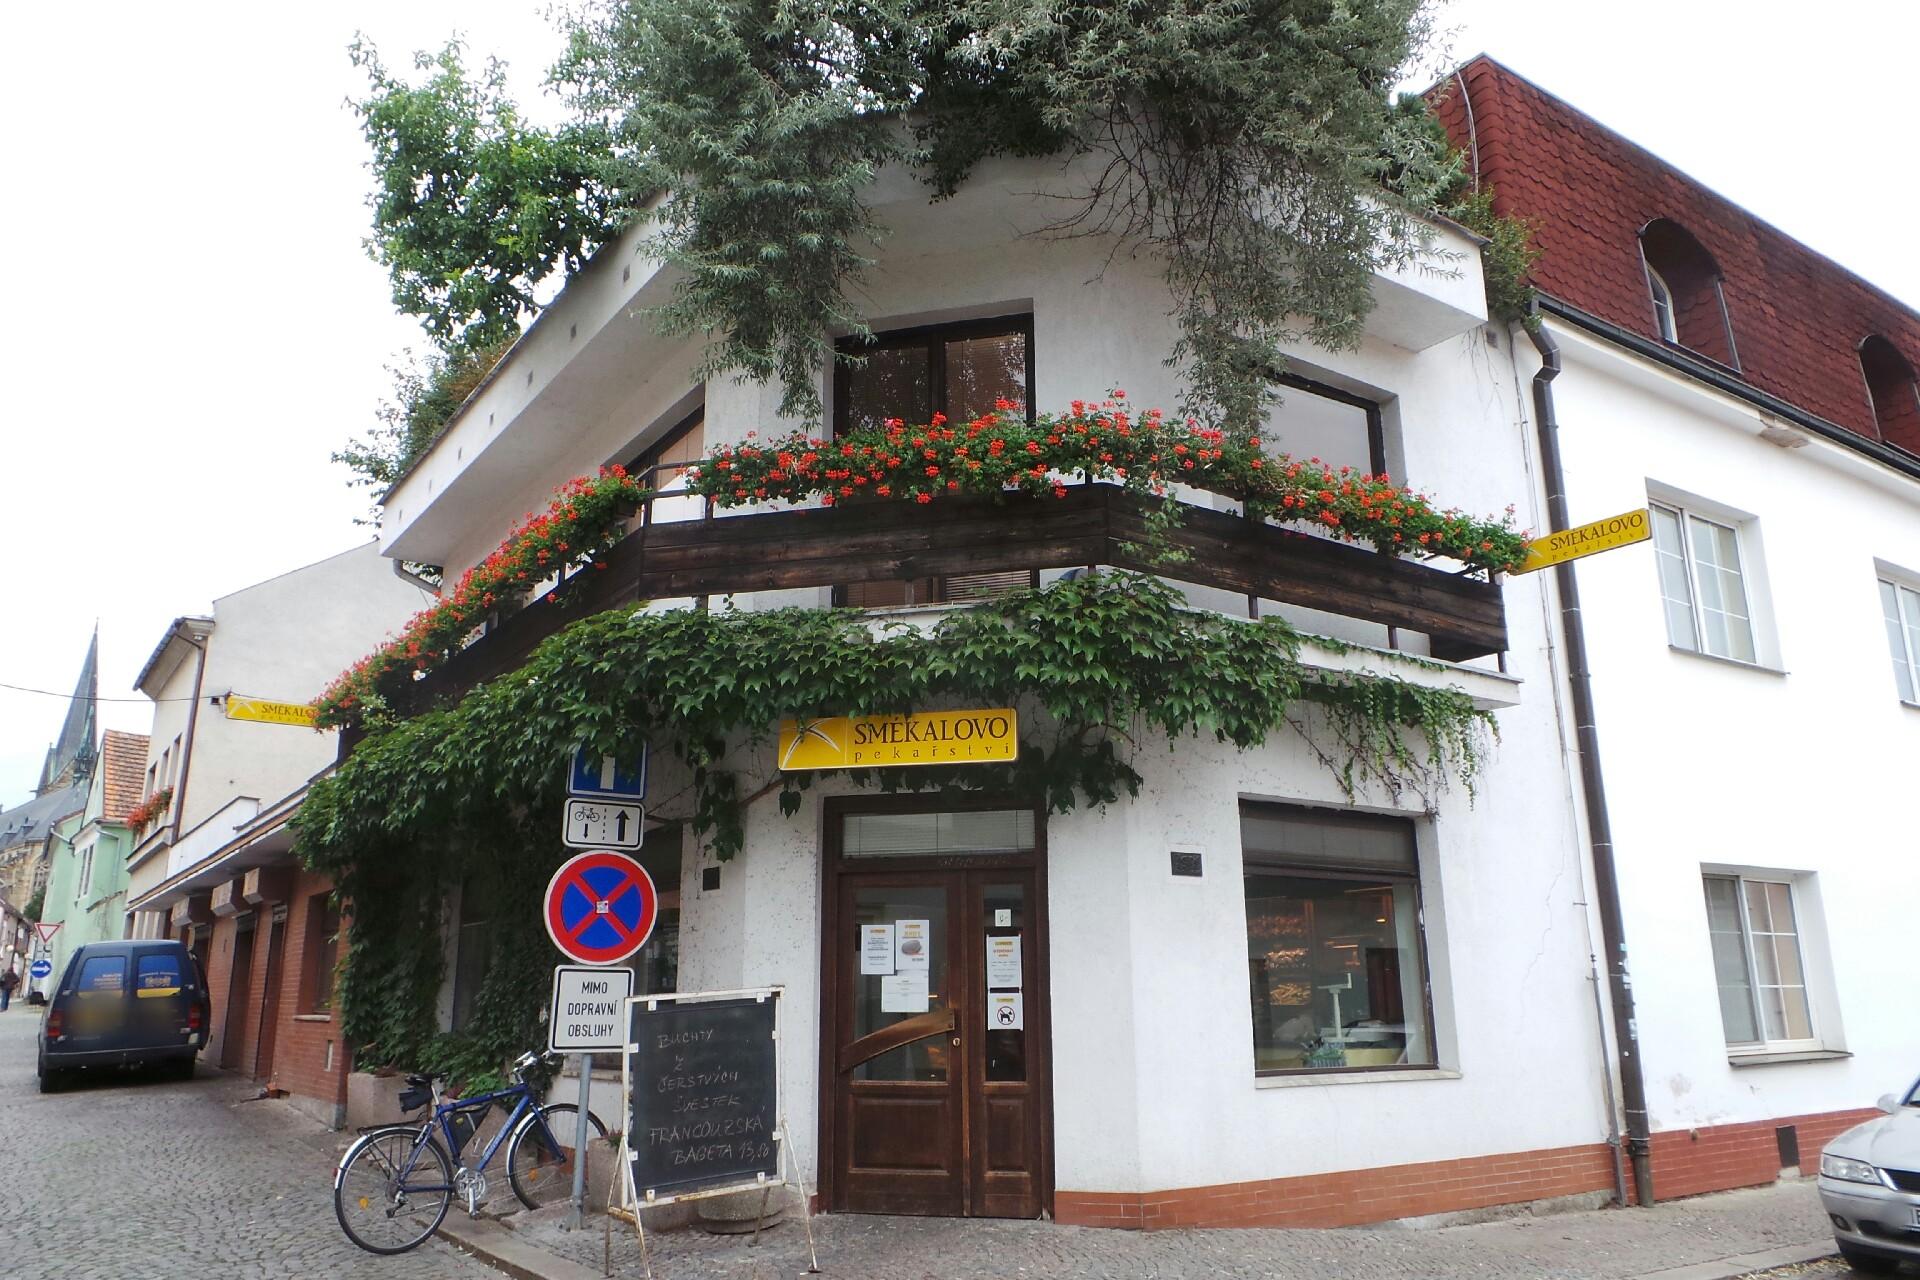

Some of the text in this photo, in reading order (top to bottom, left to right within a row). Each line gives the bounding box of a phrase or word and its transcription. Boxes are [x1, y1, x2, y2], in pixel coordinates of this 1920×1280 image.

[854, 716, 1009, 745] SMÉKALOVO
[581, 981, 608, 995] MIMO
[567, 999, 618, 1016] DOPRAVNÍ
[567, 1024, 614, 1037] OBSLUHY
[657, 1029, 713, 1049] BUCHTY
